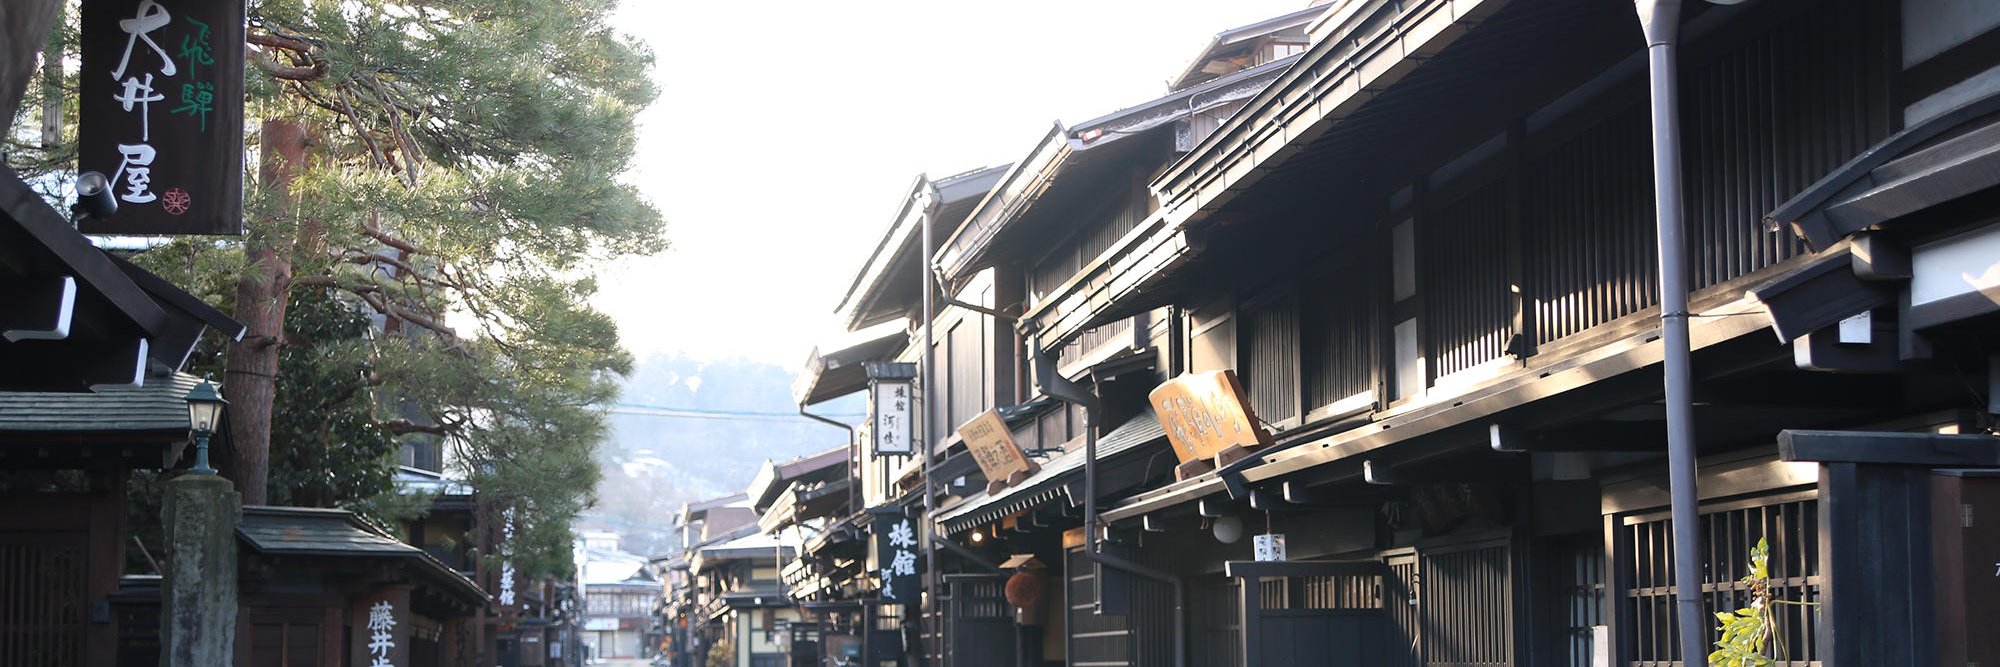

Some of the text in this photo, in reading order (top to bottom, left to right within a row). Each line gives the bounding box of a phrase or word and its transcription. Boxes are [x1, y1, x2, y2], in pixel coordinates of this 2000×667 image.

[111, 0, 177, 203] 大井屋
[889, 519, 918, 576] 旅館
